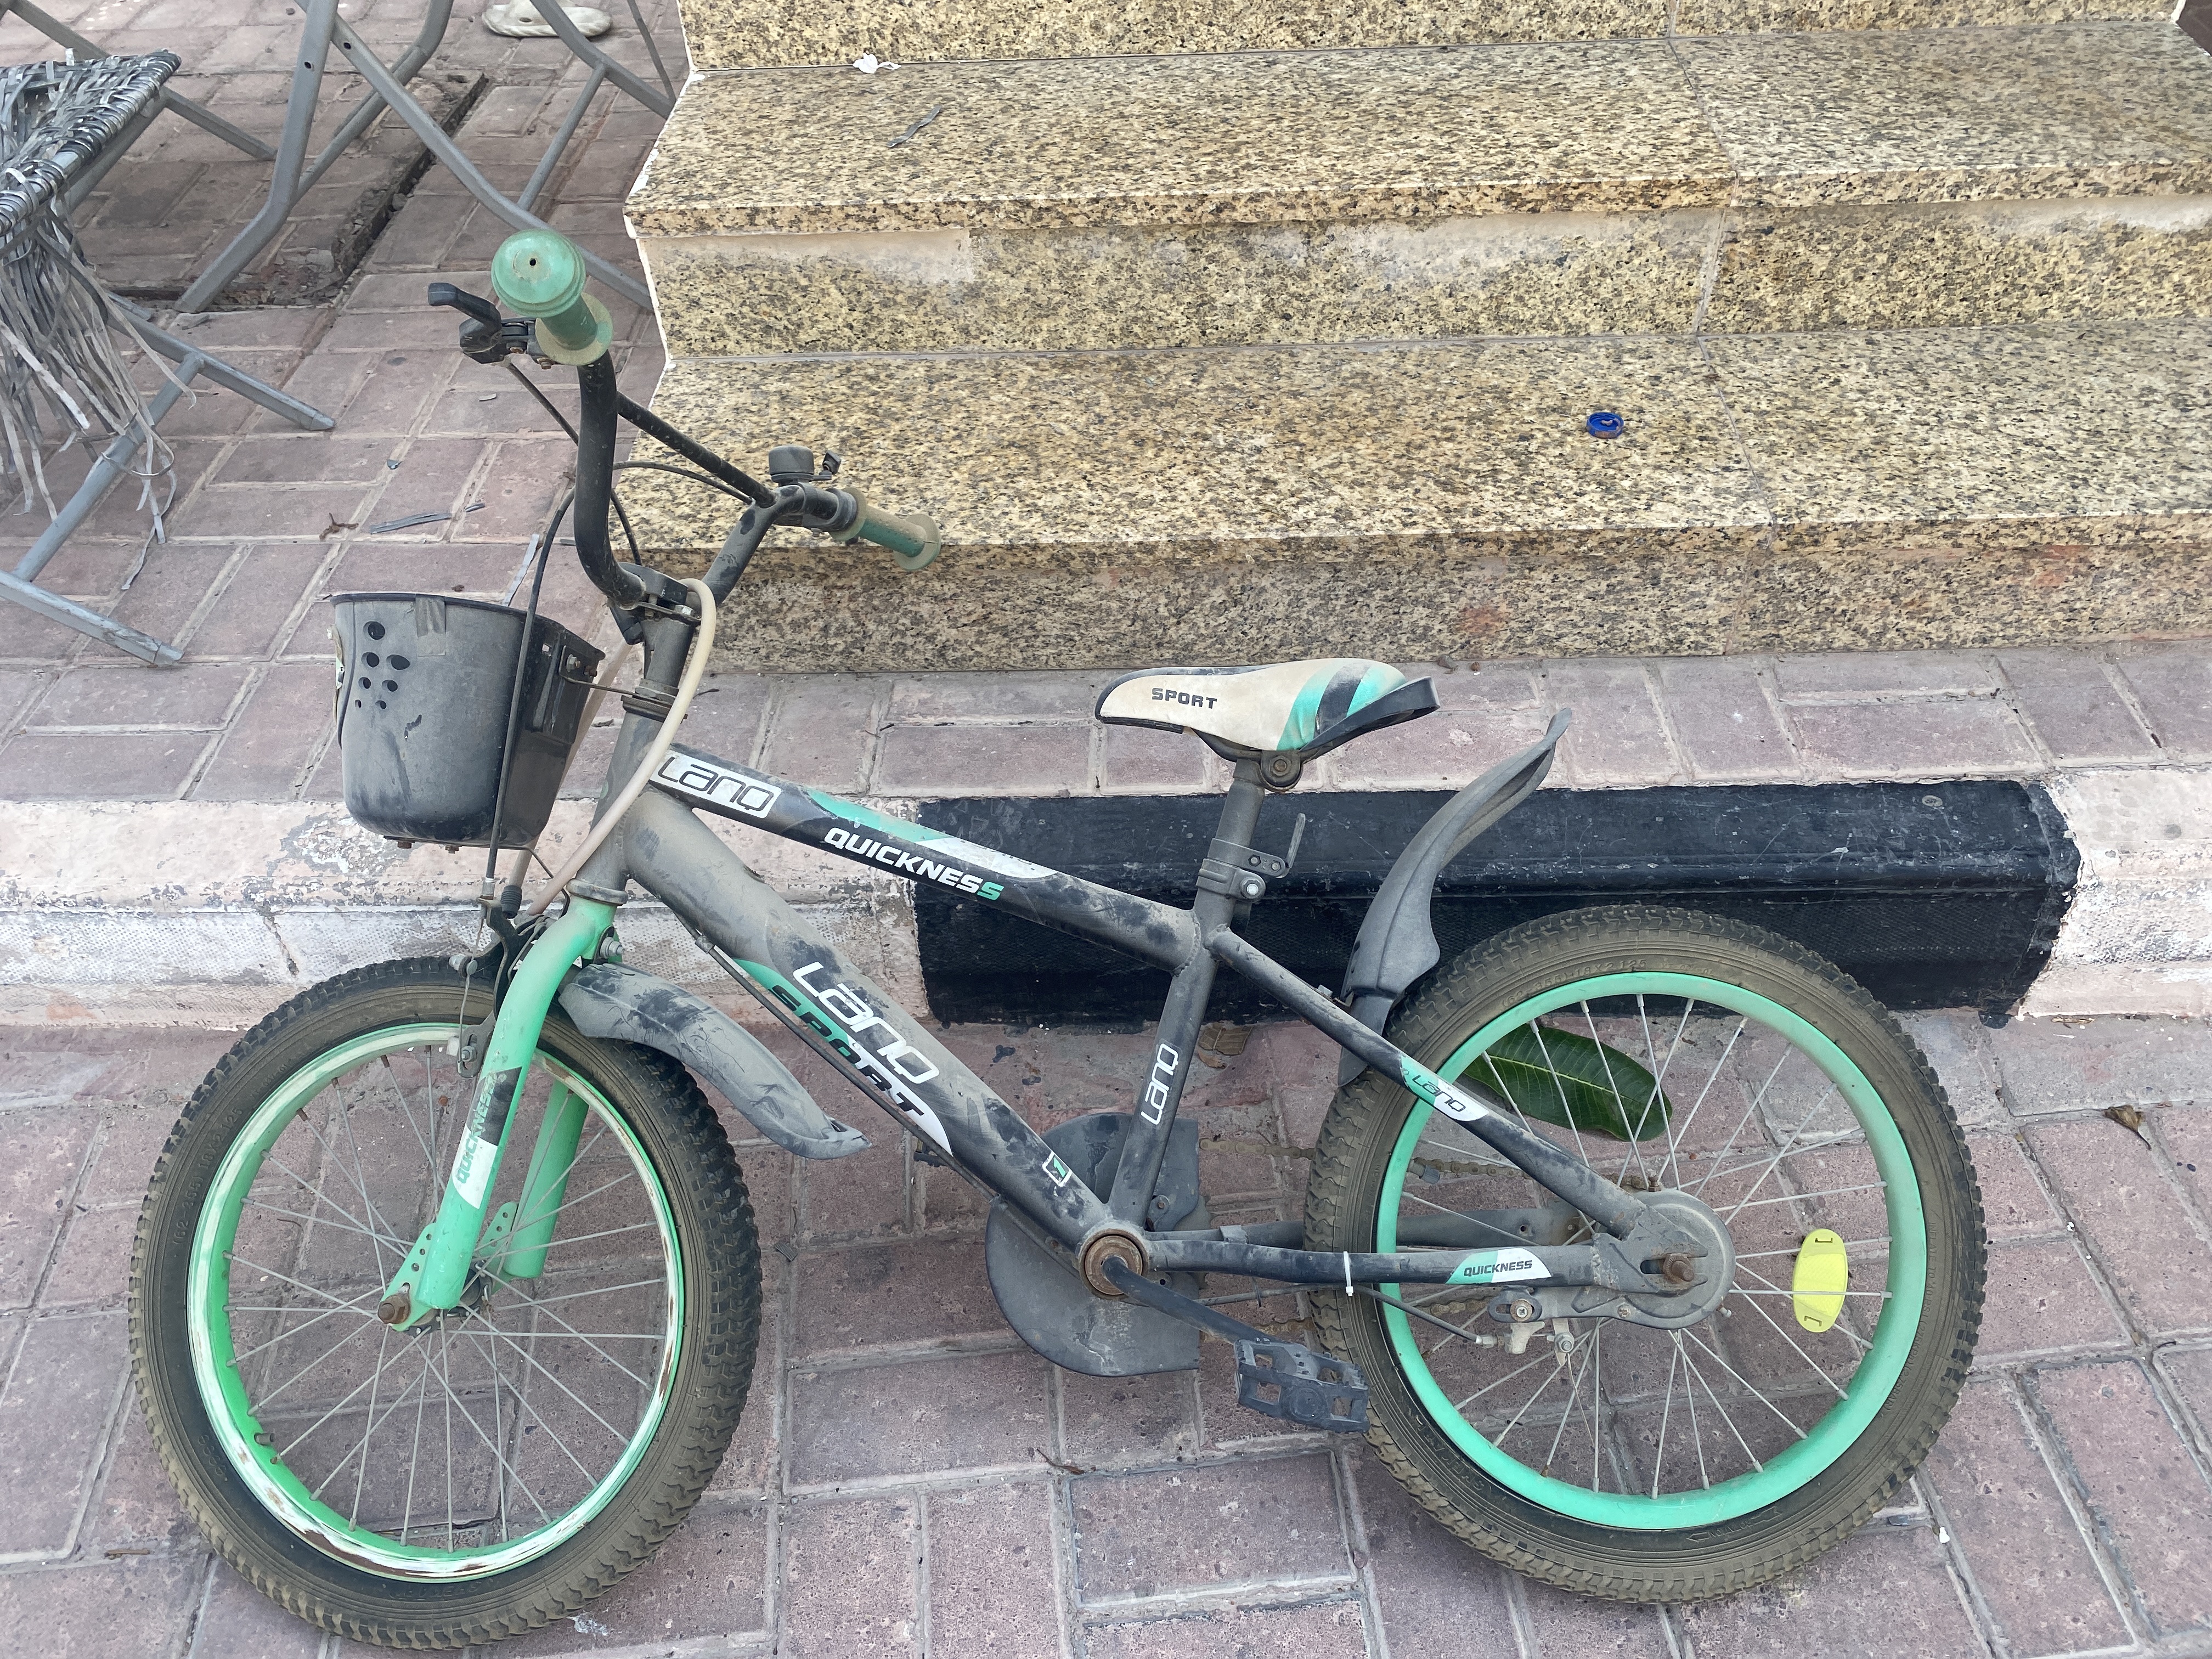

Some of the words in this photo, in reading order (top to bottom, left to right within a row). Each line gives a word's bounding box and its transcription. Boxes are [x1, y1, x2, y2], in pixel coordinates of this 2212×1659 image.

[1152, 687, 1217, 709] SPORT
[824, 827, 1005, 901] QUICKNESS
[768, 985, 925, 1116] SPORT
[1463, 1260, 1532, 1277] QUICKNESS
